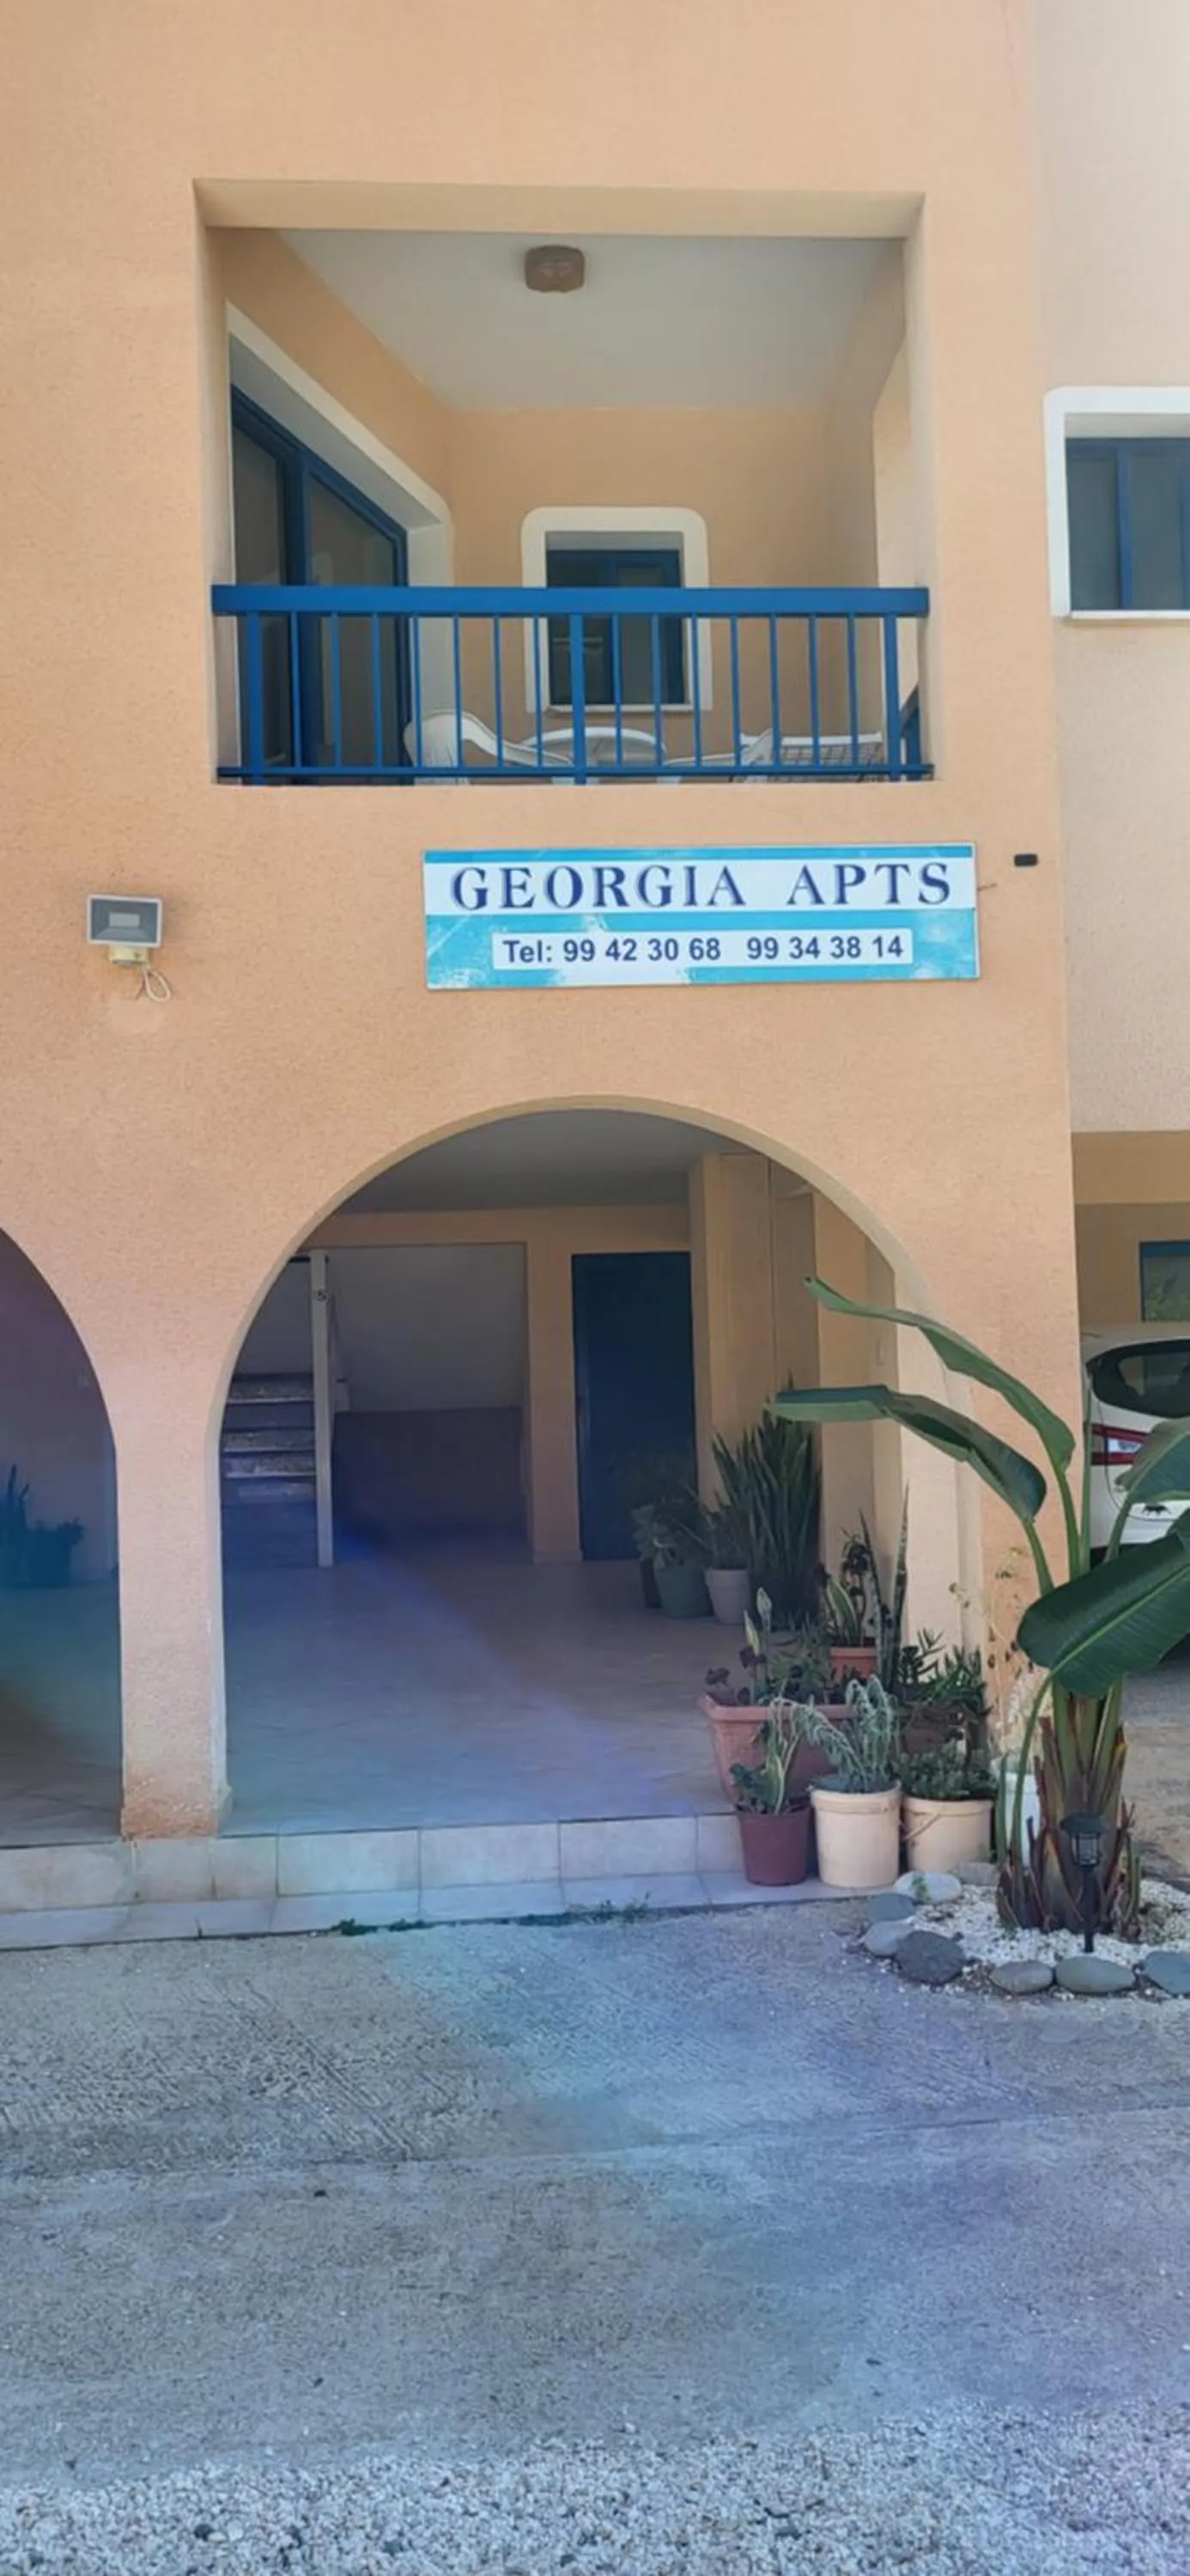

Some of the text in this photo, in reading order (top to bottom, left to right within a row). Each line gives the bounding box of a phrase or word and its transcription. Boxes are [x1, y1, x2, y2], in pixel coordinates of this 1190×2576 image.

[451, 862, 951, 911] GEORGIA APTS
[502, 933, 904, 963] Tel: 99 42 30 68 99 34 38 14
